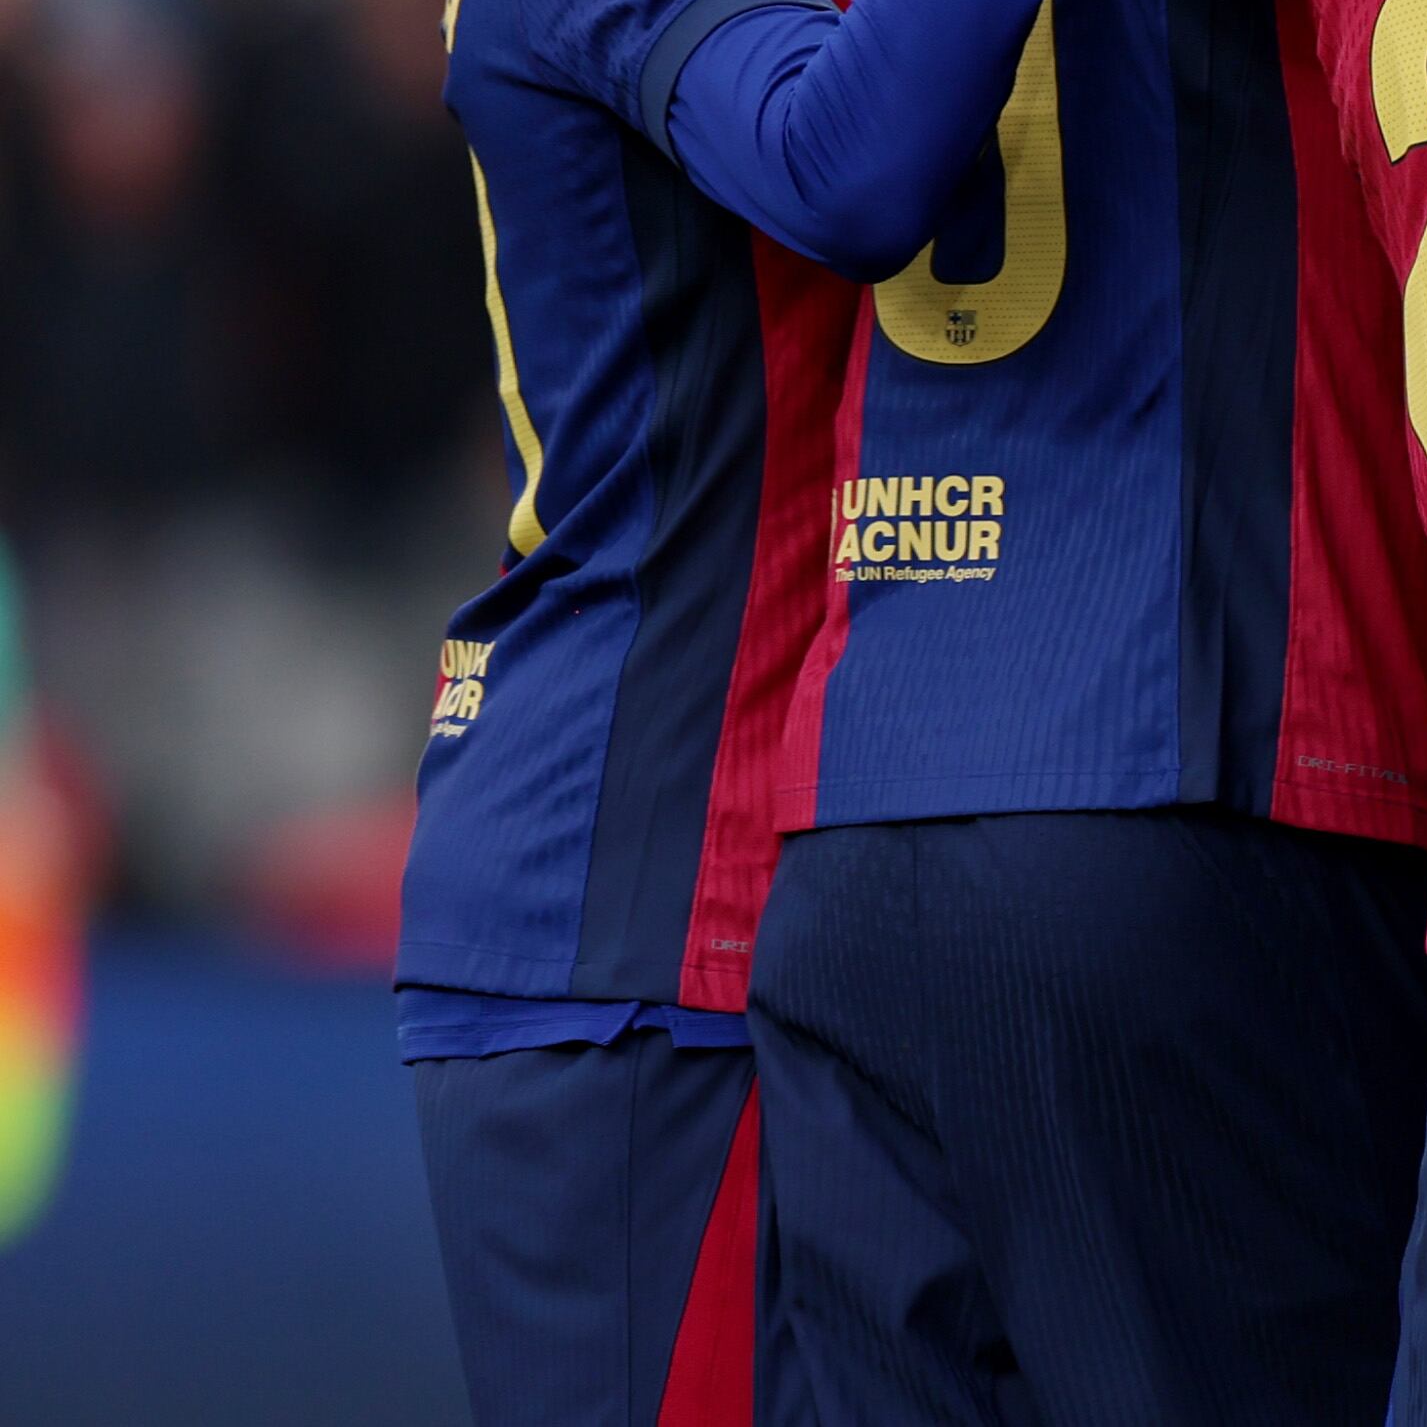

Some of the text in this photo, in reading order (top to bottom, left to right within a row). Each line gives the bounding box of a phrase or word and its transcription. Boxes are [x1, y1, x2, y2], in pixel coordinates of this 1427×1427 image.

[842, 475, 1004, 520] UNHCR
[835, 520, 1002, 564] ACNUR
[835, 565, 996, 583] The UN Refugee Agency
